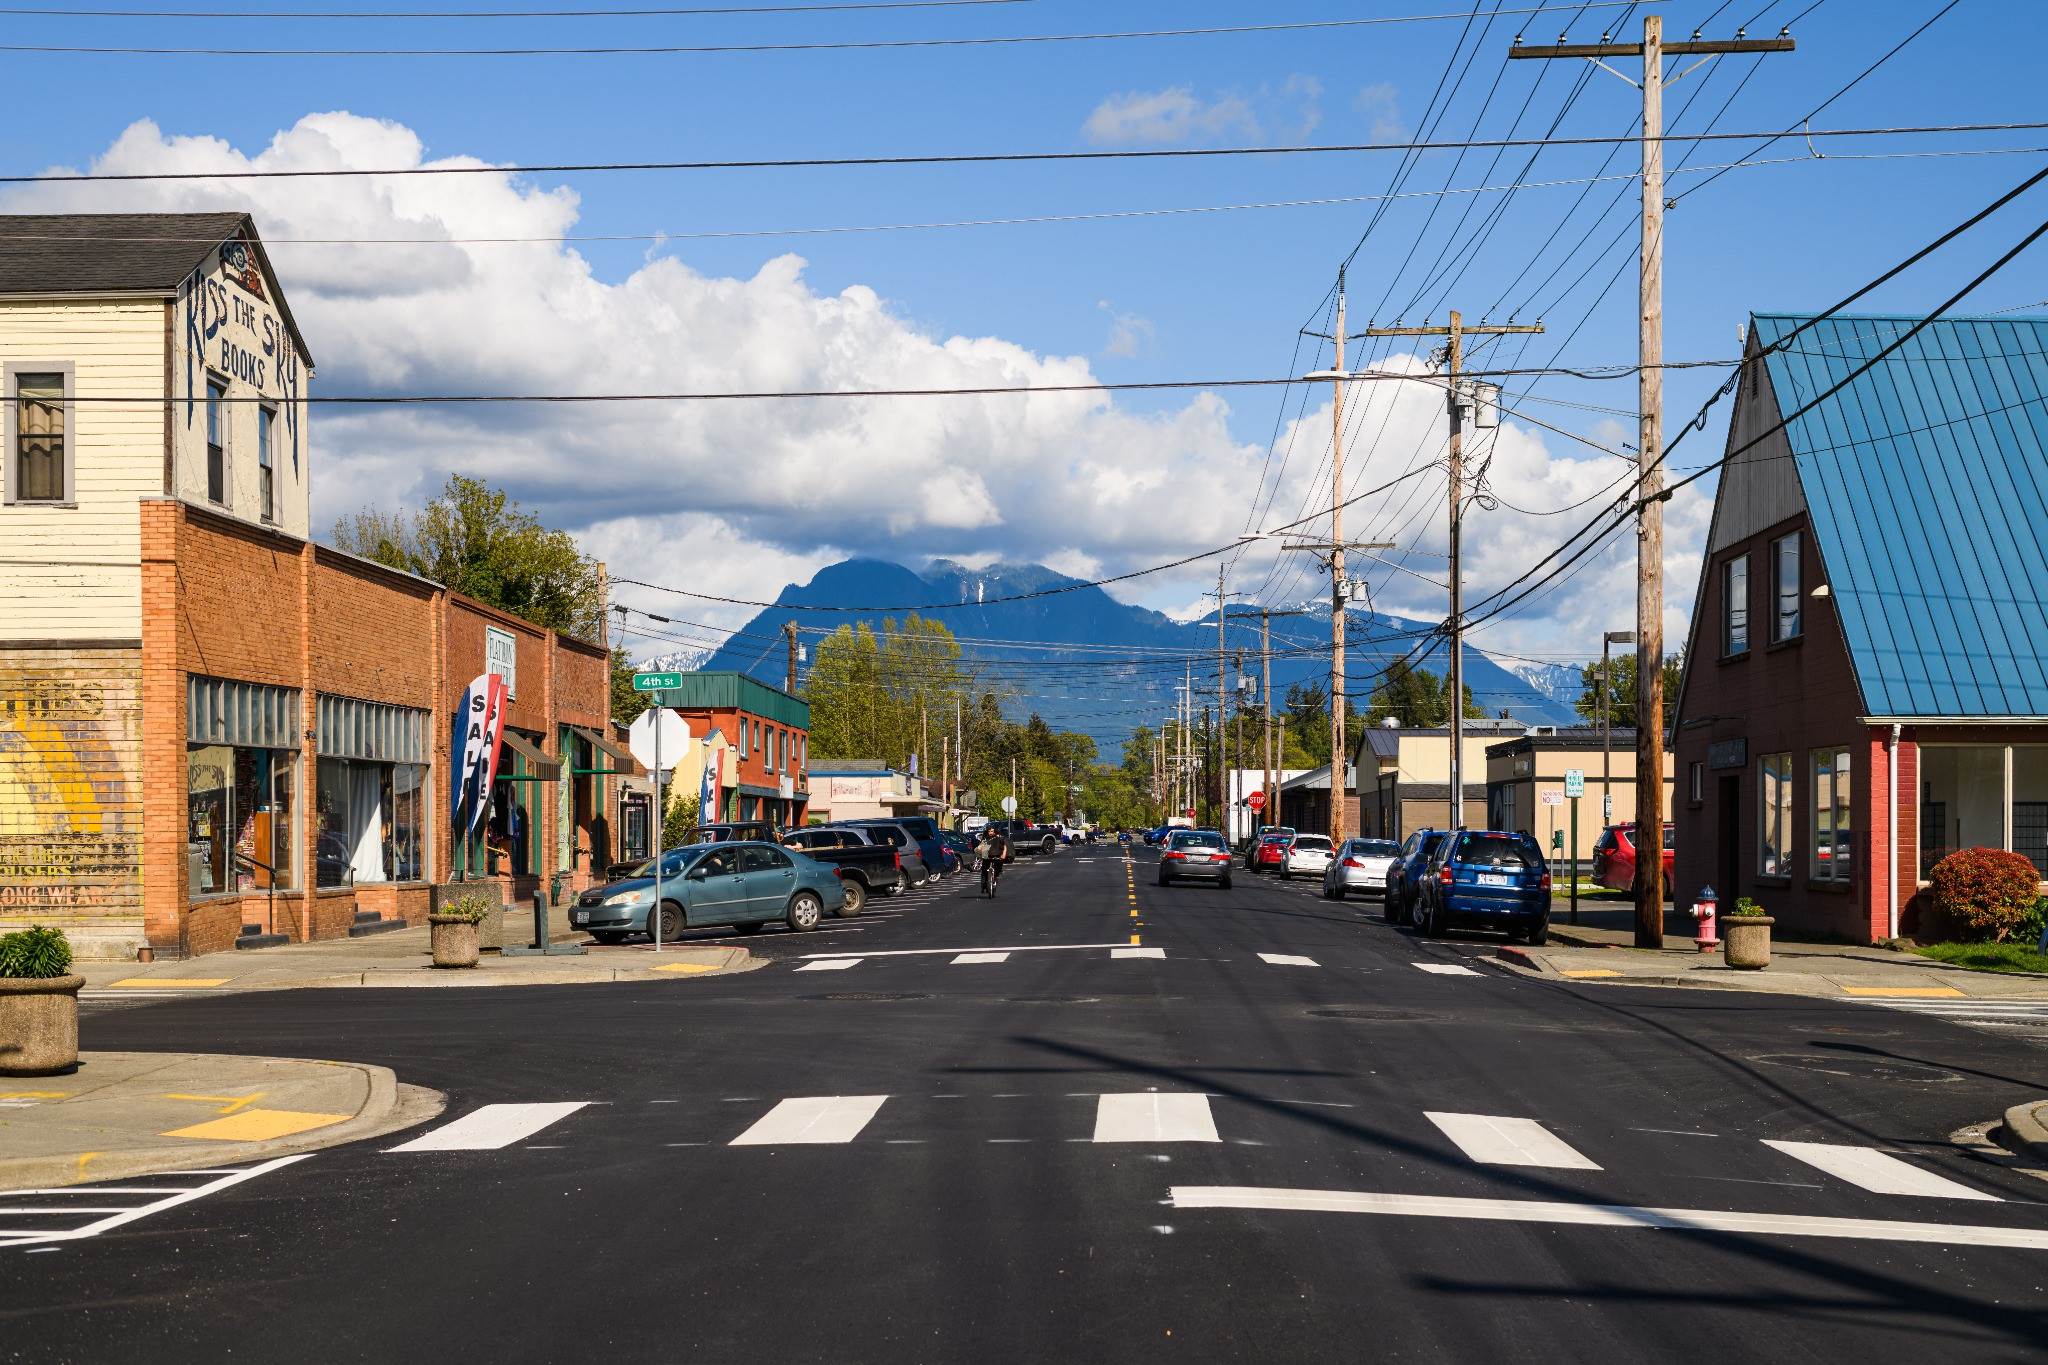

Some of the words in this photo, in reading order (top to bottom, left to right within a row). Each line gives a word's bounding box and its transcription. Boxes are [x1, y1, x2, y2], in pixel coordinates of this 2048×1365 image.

[187, 268, 228, 431] KISS
[232, 294, 258, 337] THE
[221, 336, 265, 390] BOOKS
[642, 677, 662, 687] 4th
[1249, 796, 1266, 804] STOP
